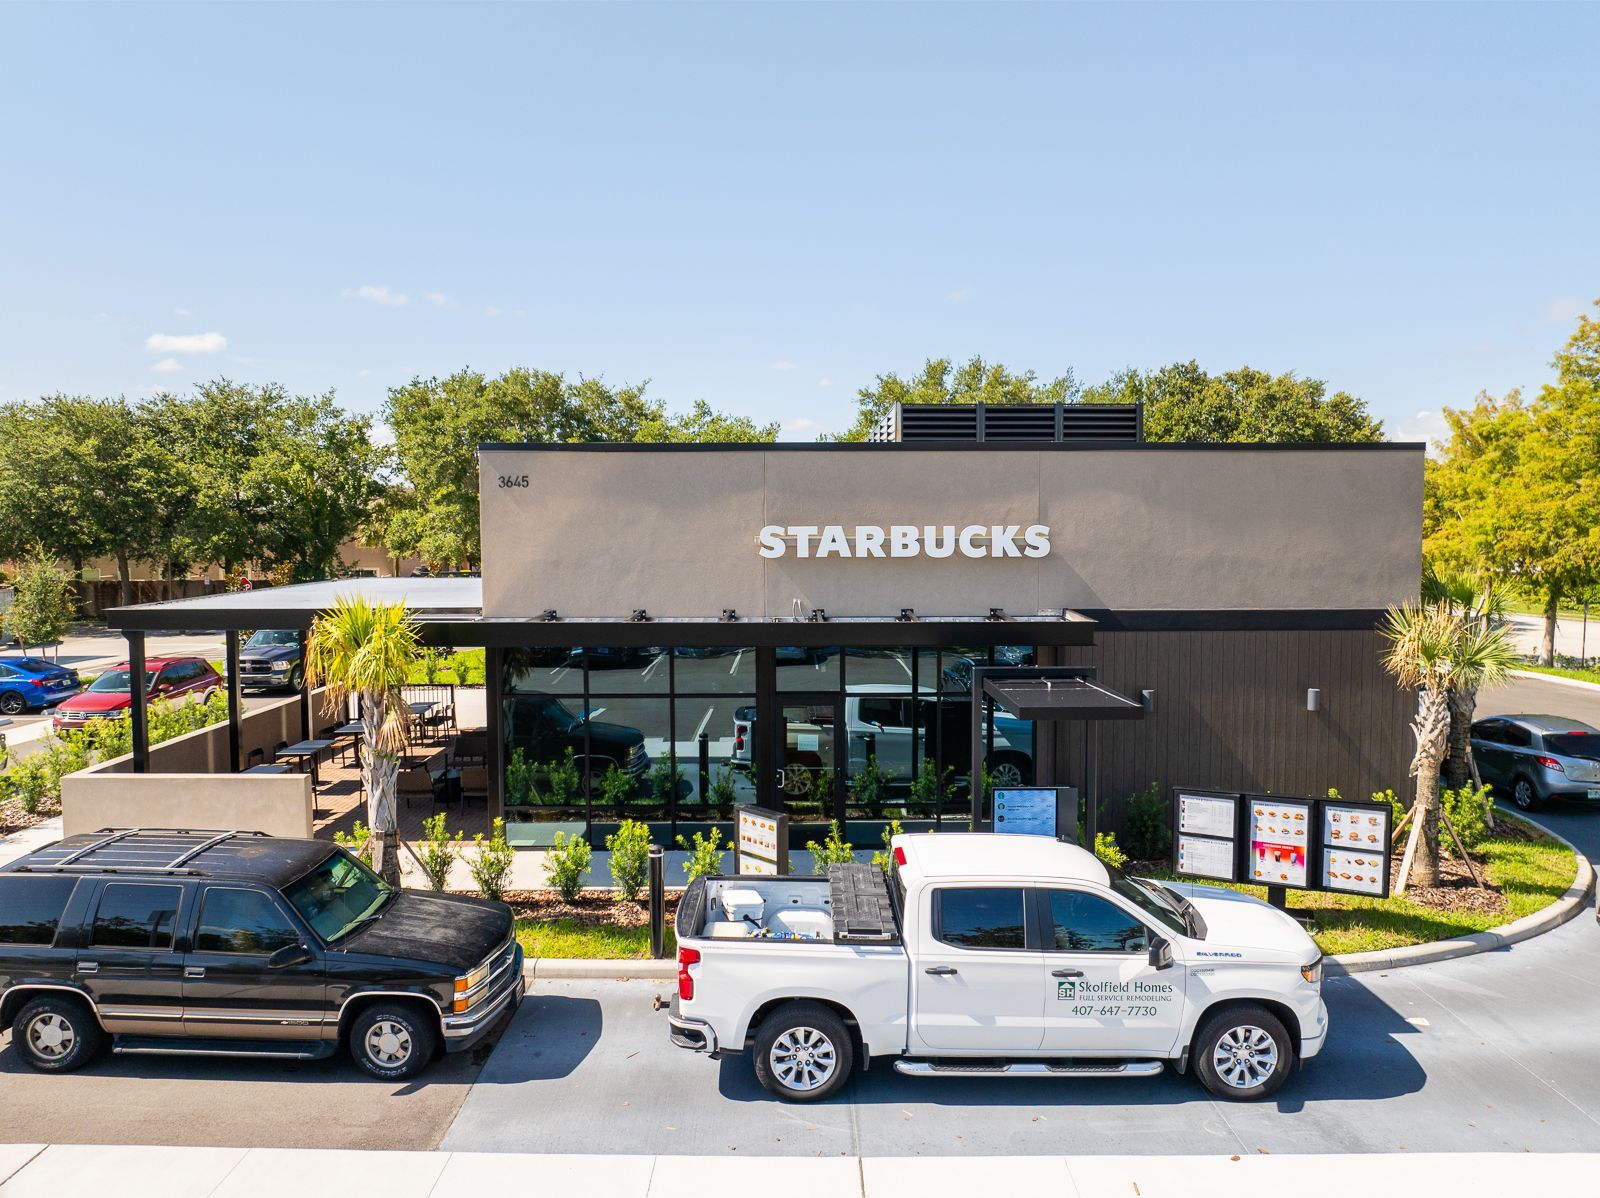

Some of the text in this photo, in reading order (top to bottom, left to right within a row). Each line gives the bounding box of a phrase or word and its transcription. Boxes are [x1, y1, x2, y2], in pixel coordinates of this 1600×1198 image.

[498, 475, 529, 488] 3645
[759, 525, 1051, 558] STARBUCKS
[1079, 981, 1173, 993] Skolfield Homes
[1058, 988, 1075, 998] SH
[1079, 994, 1172, 1002] FULL SERVICE REMODELING
[1071, 1005, 1157, 1016] 407-647-7730
